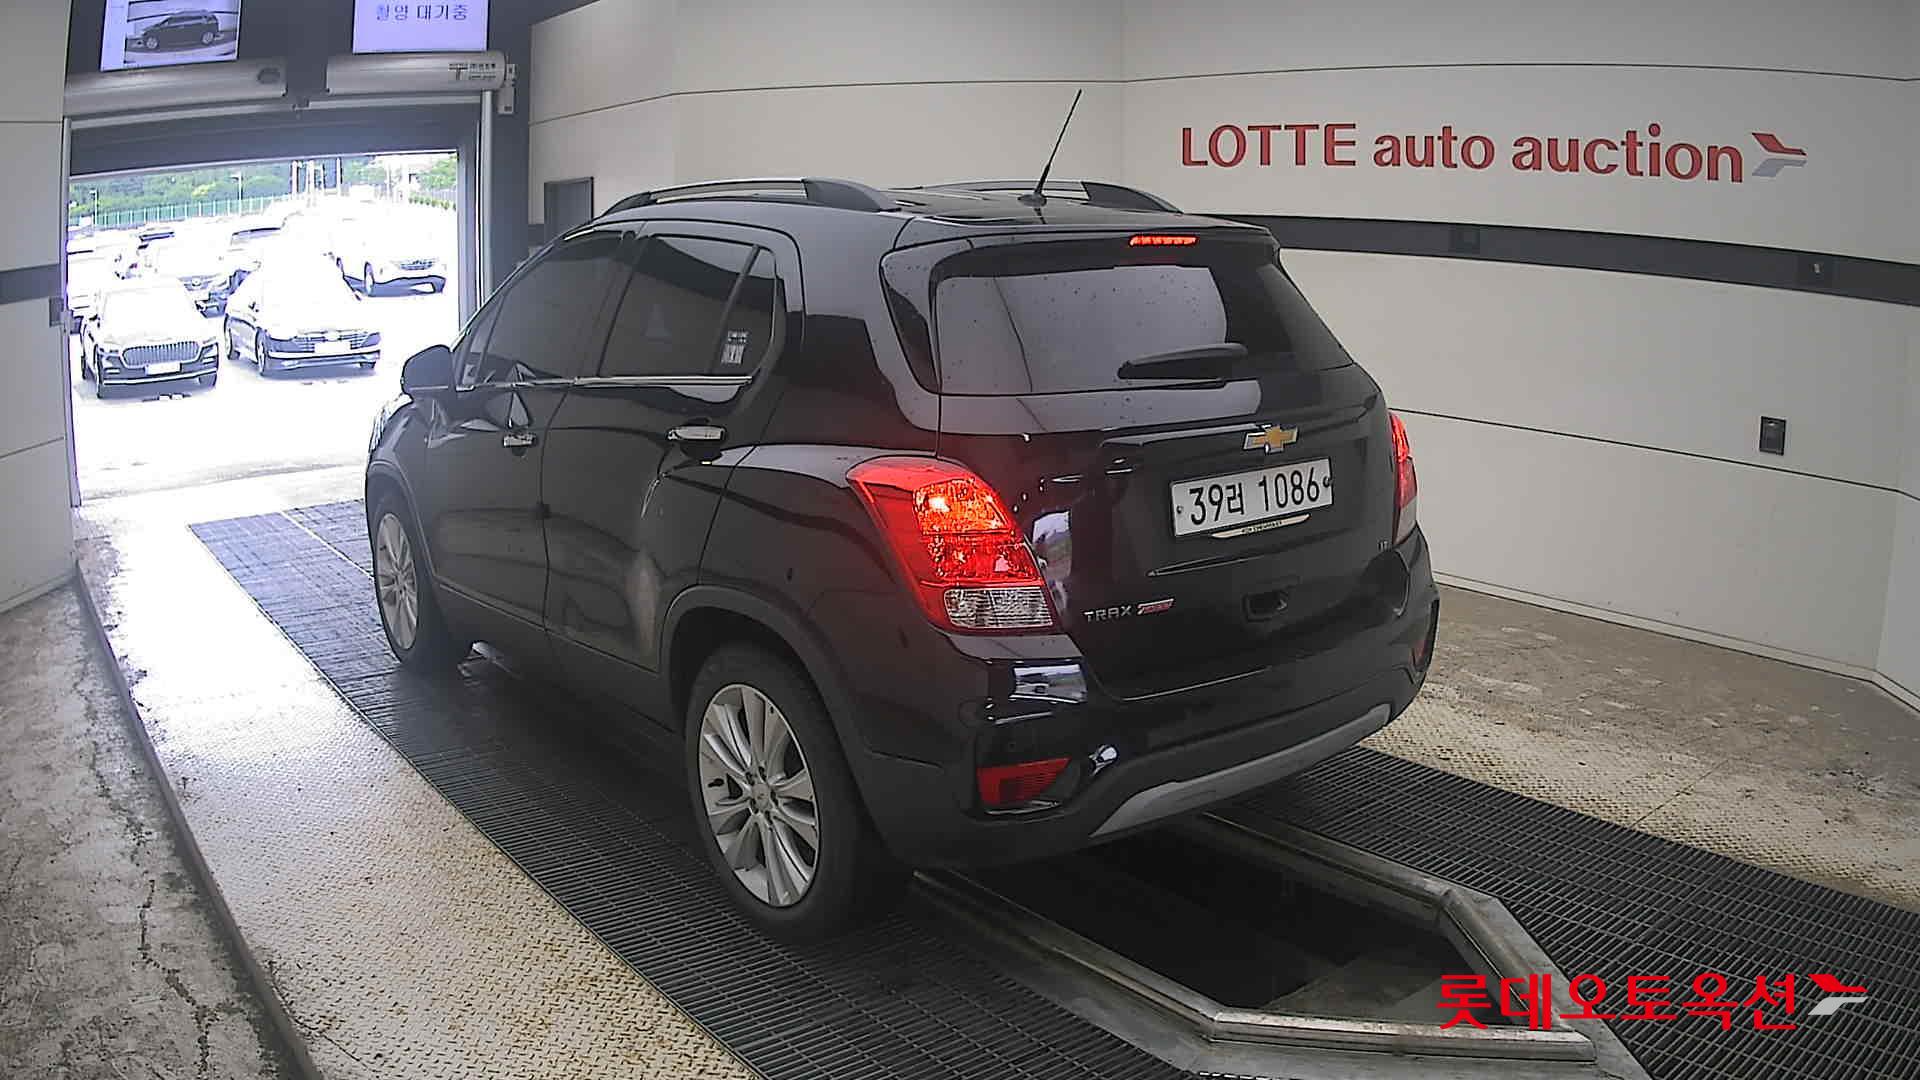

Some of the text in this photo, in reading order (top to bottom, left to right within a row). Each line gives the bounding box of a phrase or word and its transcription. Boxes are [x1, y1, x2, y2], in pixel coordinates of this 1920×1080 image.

[1181, 123, 1744, 183] LOTTE auto auction
[1189, 466, 1321, 526] 39러 1086
[1084, 605, 1132, 622] TRAX
